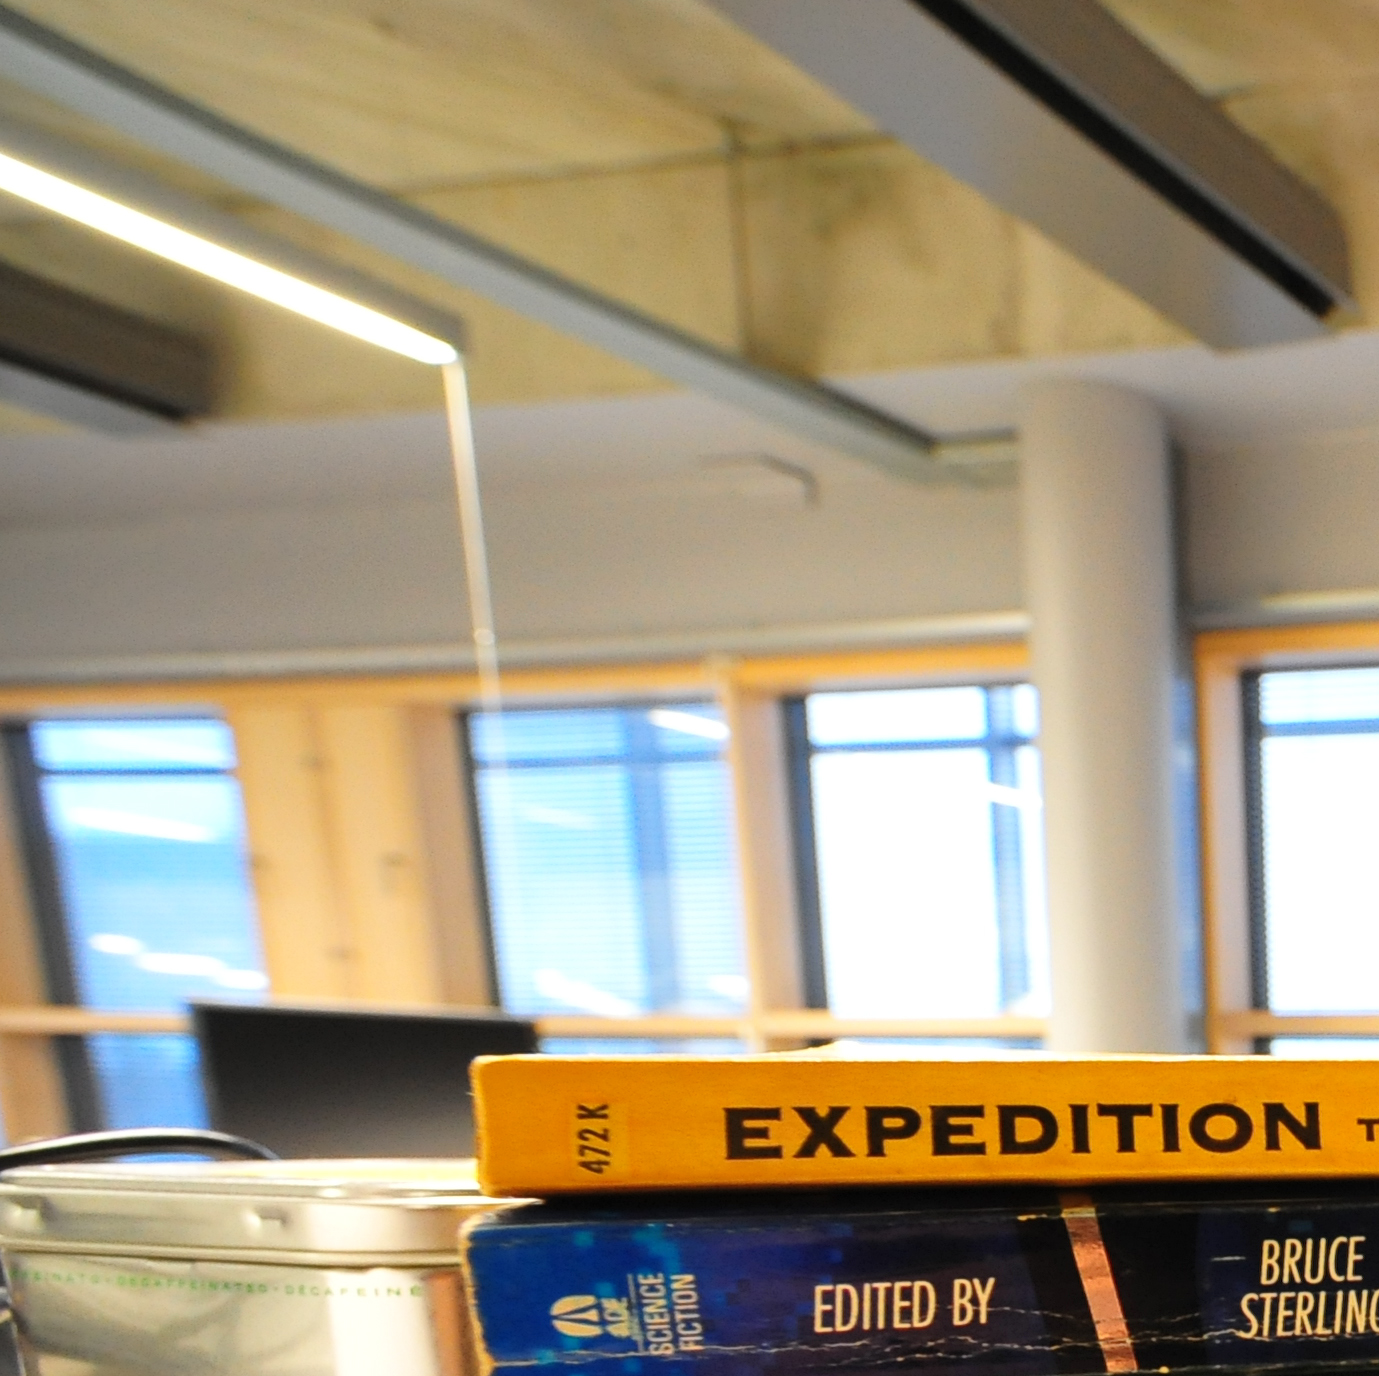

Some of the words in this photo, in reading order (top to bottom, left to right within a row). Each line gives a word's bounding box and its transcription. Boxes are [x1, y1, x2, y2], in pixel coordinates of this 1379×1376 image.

[578, 1103, 609, 1119] K
[723, 1101, 1322, 1161] EXPEDITION
[577, 1128, 610, 1174] 472
[1259, 1235, 1365, 1287] BRUCE
[637, 1273, 674, 1354] SCIENCE
[670, 1274, 704, 1350] FICTION
[812, 1280, 937, 1335] EDITED
[952, 1277, 996, 1327] BY
